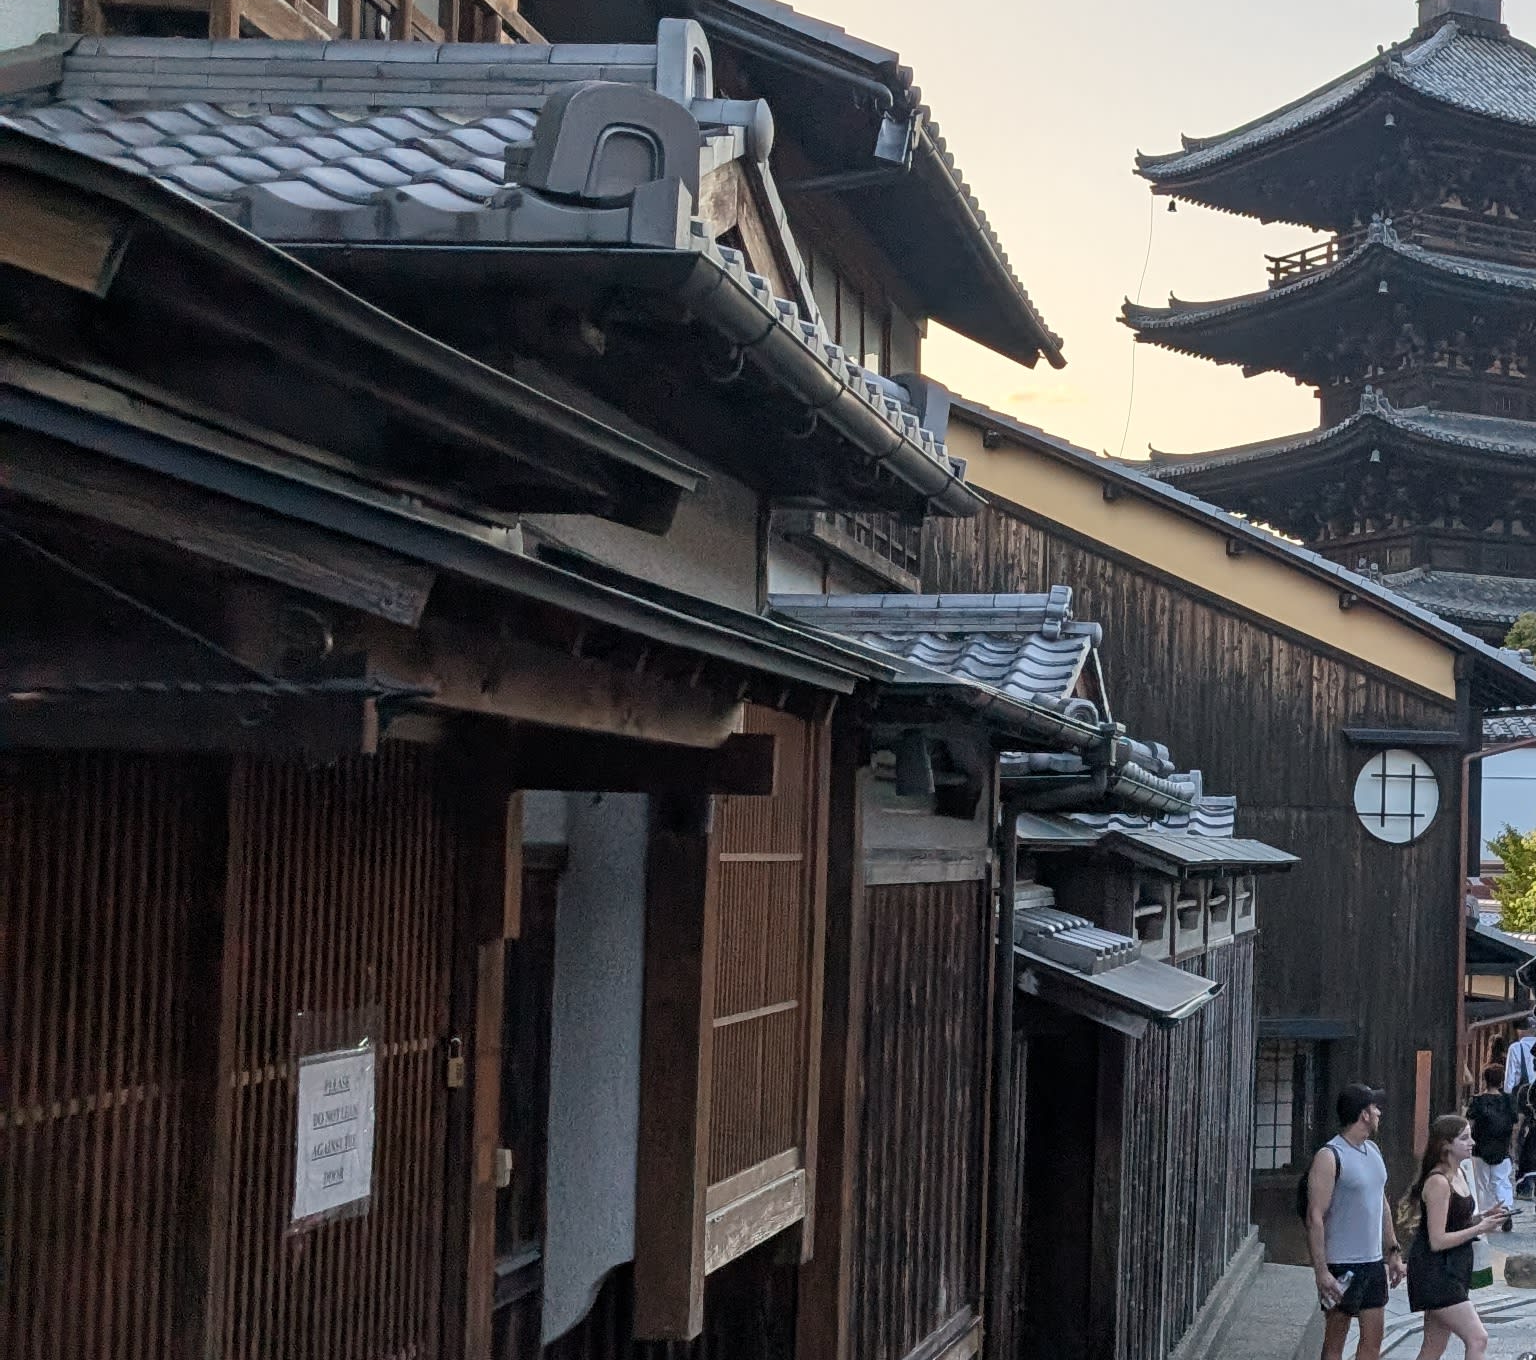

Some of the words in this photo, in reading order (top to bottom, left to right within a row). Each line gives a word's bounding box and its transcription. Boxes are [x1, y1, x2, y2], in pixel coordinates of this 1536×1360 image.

[324, 1076, 351, 1094] PLEASE
[313, 1112, 325, 1127] DO
[325, 1107, 340, 1124] NOT
[341, 1103, 359, 1120] LEAN
[311, 1138, 344, 1158] AGAINST
[323, 1166, 345, 1185] DOOR
